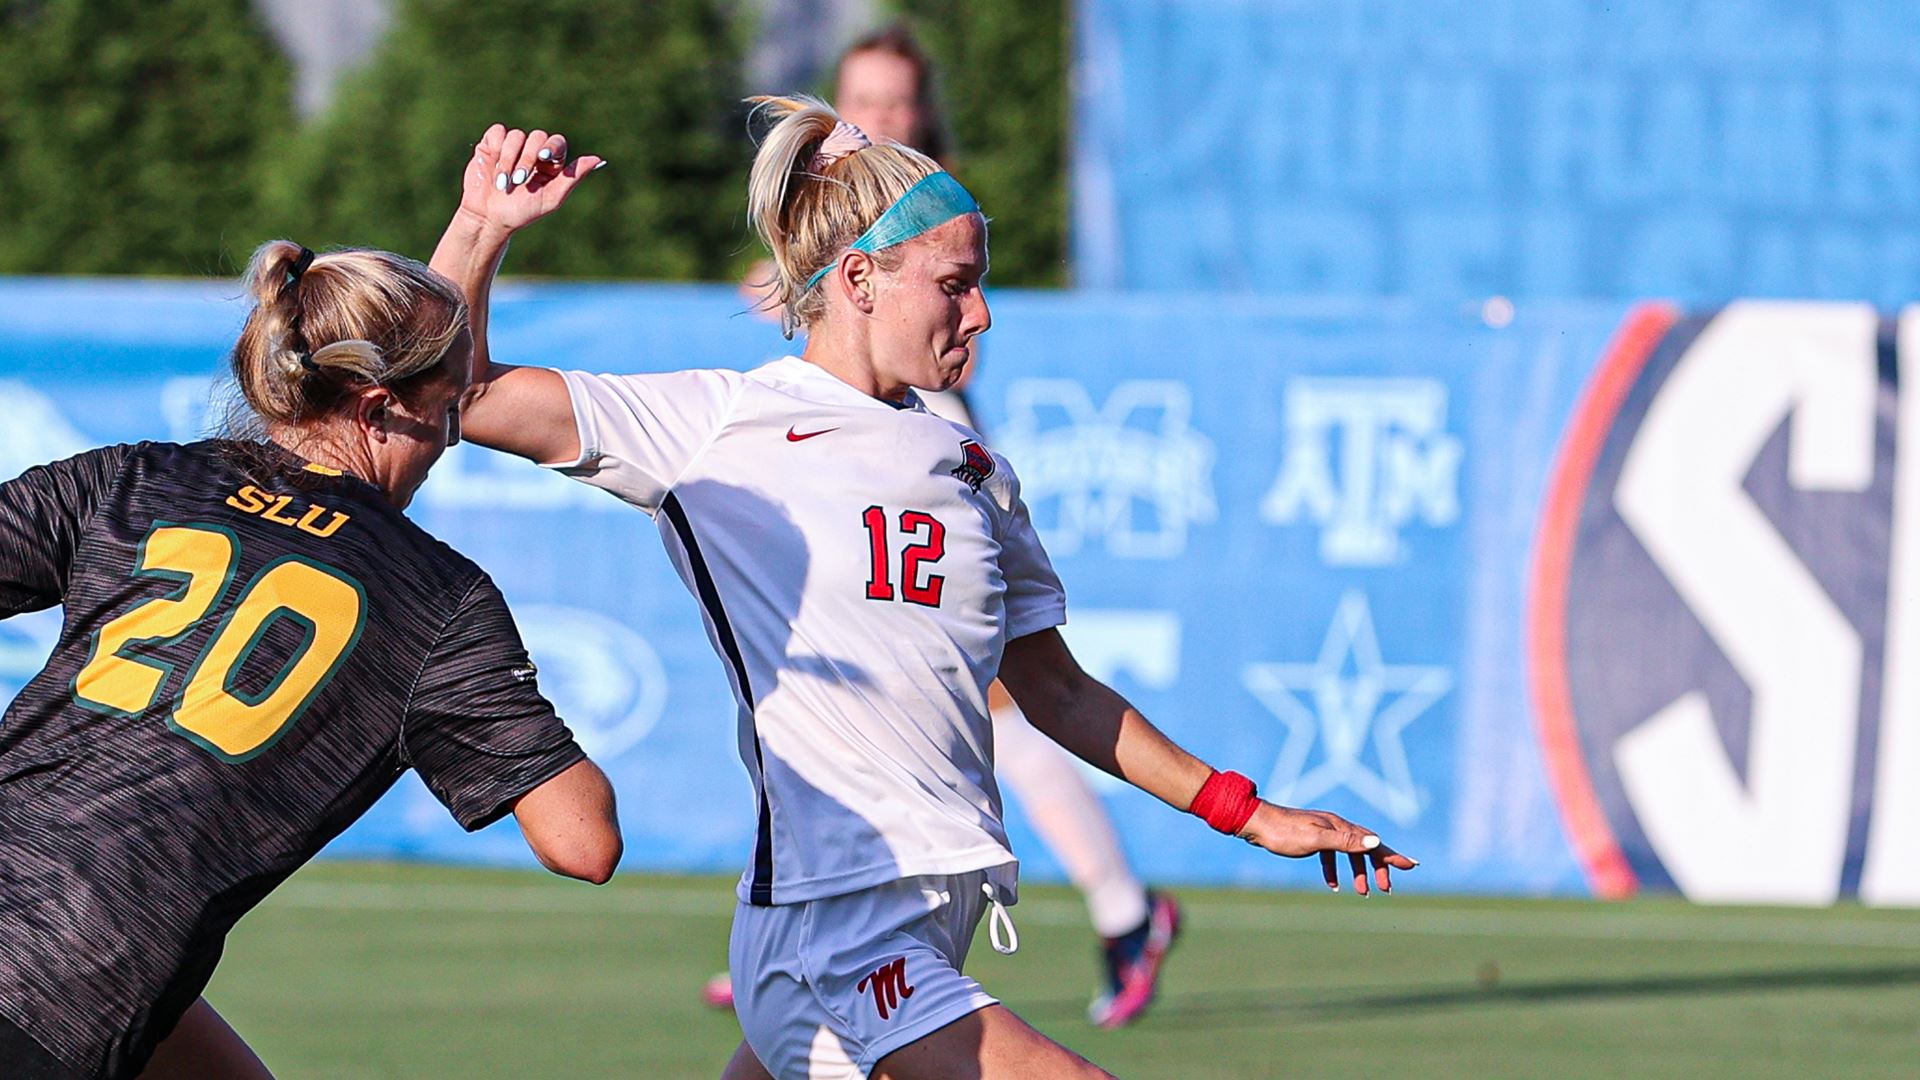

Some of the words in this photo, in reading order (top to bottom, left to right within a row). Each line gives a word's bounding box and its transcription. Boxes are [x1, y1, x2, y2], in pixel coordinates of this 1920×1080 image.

[226, 485, 350, 538] SLU
[863, 505, 945, 608] 12
[70, 519, 367, 764] 20
[1612, 300, 1920, 907] S
